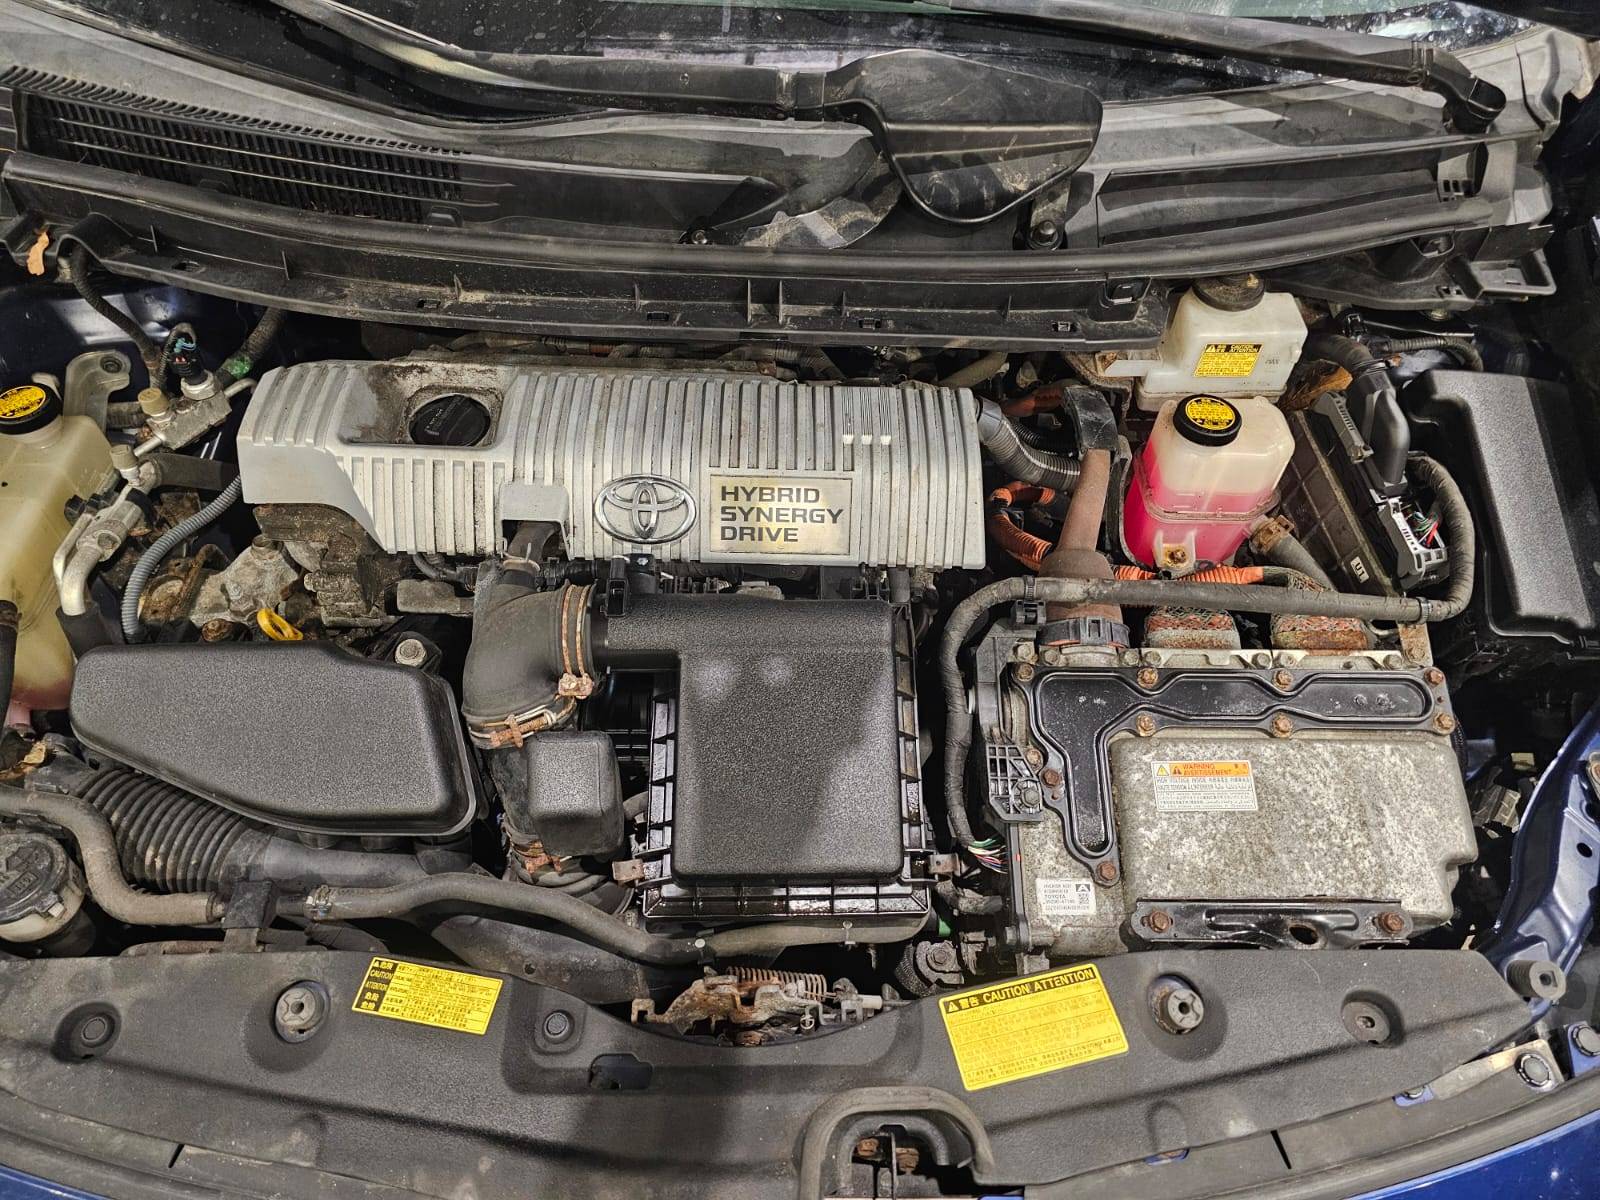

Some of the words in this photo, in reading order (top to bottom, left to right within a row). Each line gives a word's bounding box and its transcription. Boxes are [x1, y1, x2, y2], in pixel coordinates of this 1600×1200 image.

[721, 485, 820, 503] HYBRID
[720, 506, 843, 524] SYNERGY
[720, 526, 799, 542] DRIVE
[1355, 562, 1365, 577] U1
[370, 969, 394, 980] CAUTION
[983, 984, 1030, 1004] CAUTION
[1034, 969, 1094, 992] ATTENTION
